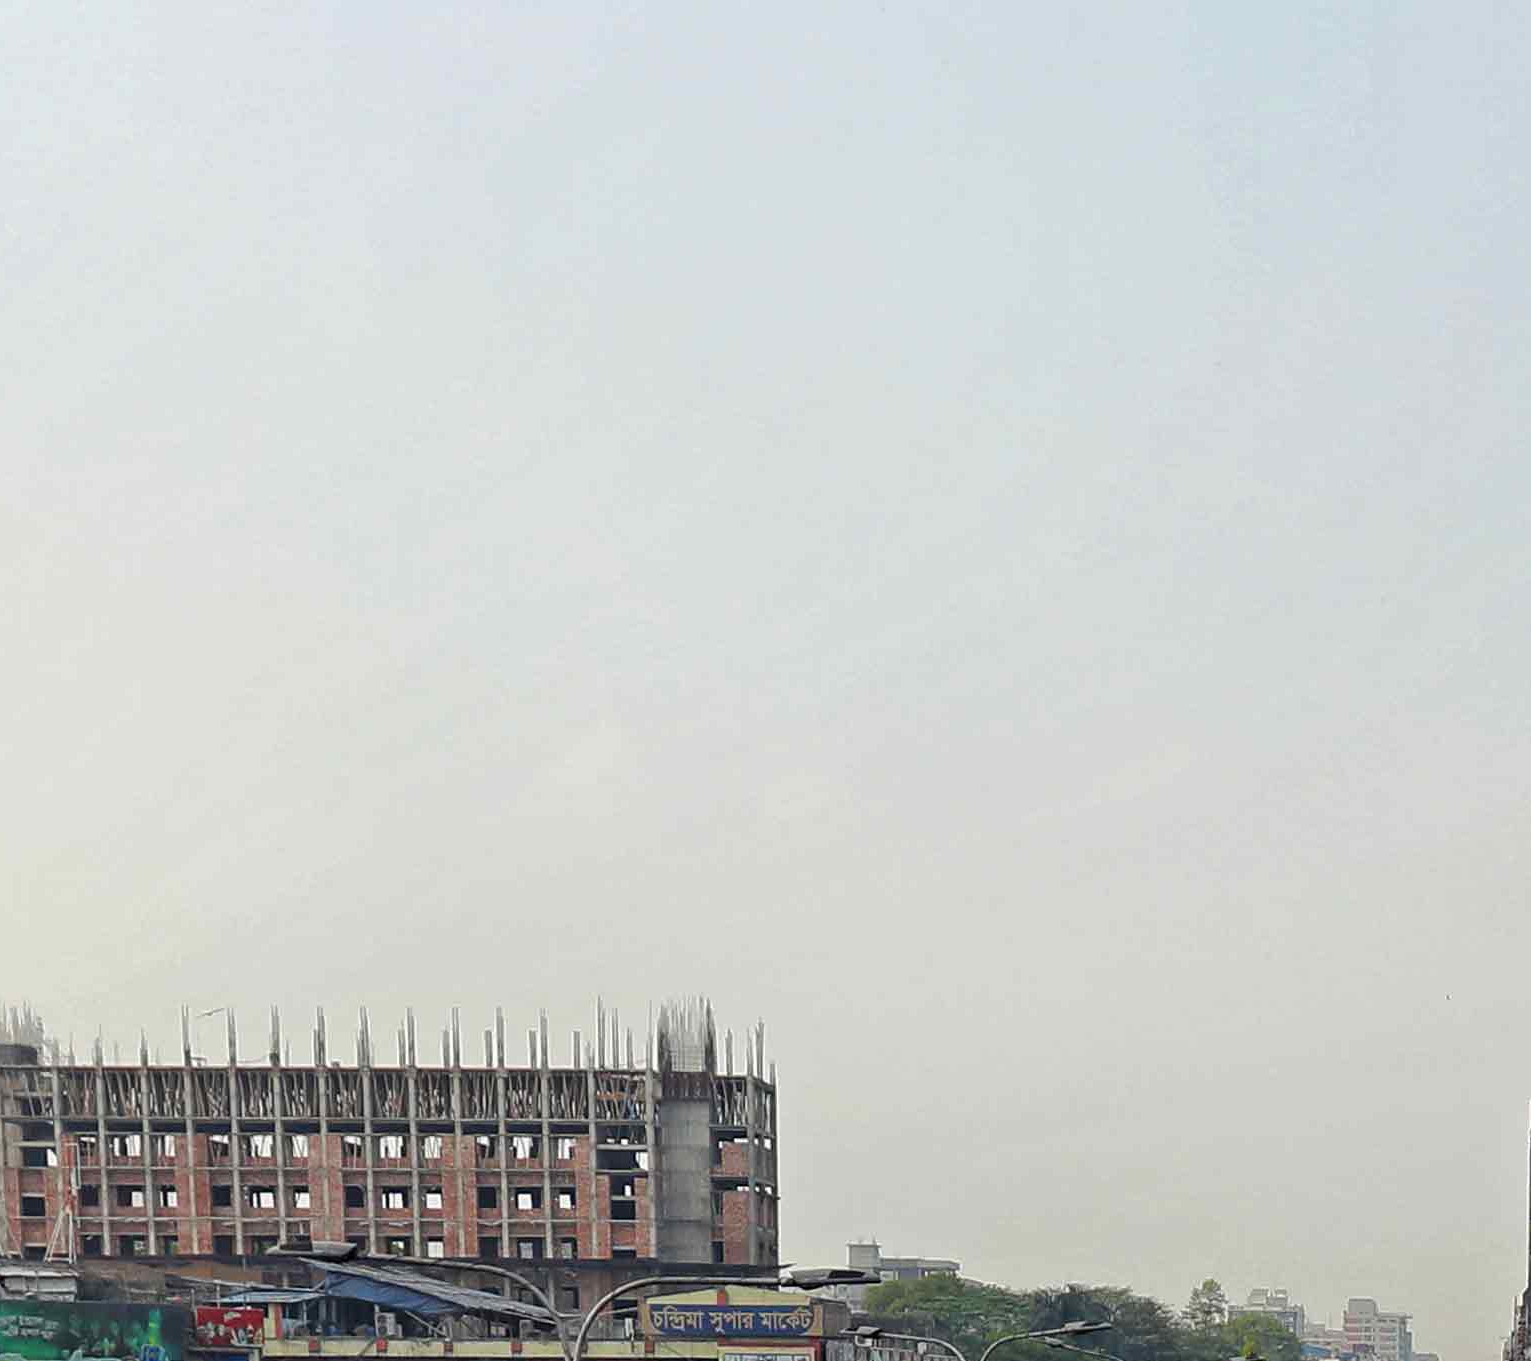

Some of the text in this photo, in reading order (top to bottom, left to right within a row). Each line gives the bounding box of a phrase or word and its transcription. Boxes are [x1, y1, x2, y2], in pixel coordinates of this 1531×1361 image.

[652, 1305, 813, 1333] চন্দ্রিমা সুপার মার্কেট
